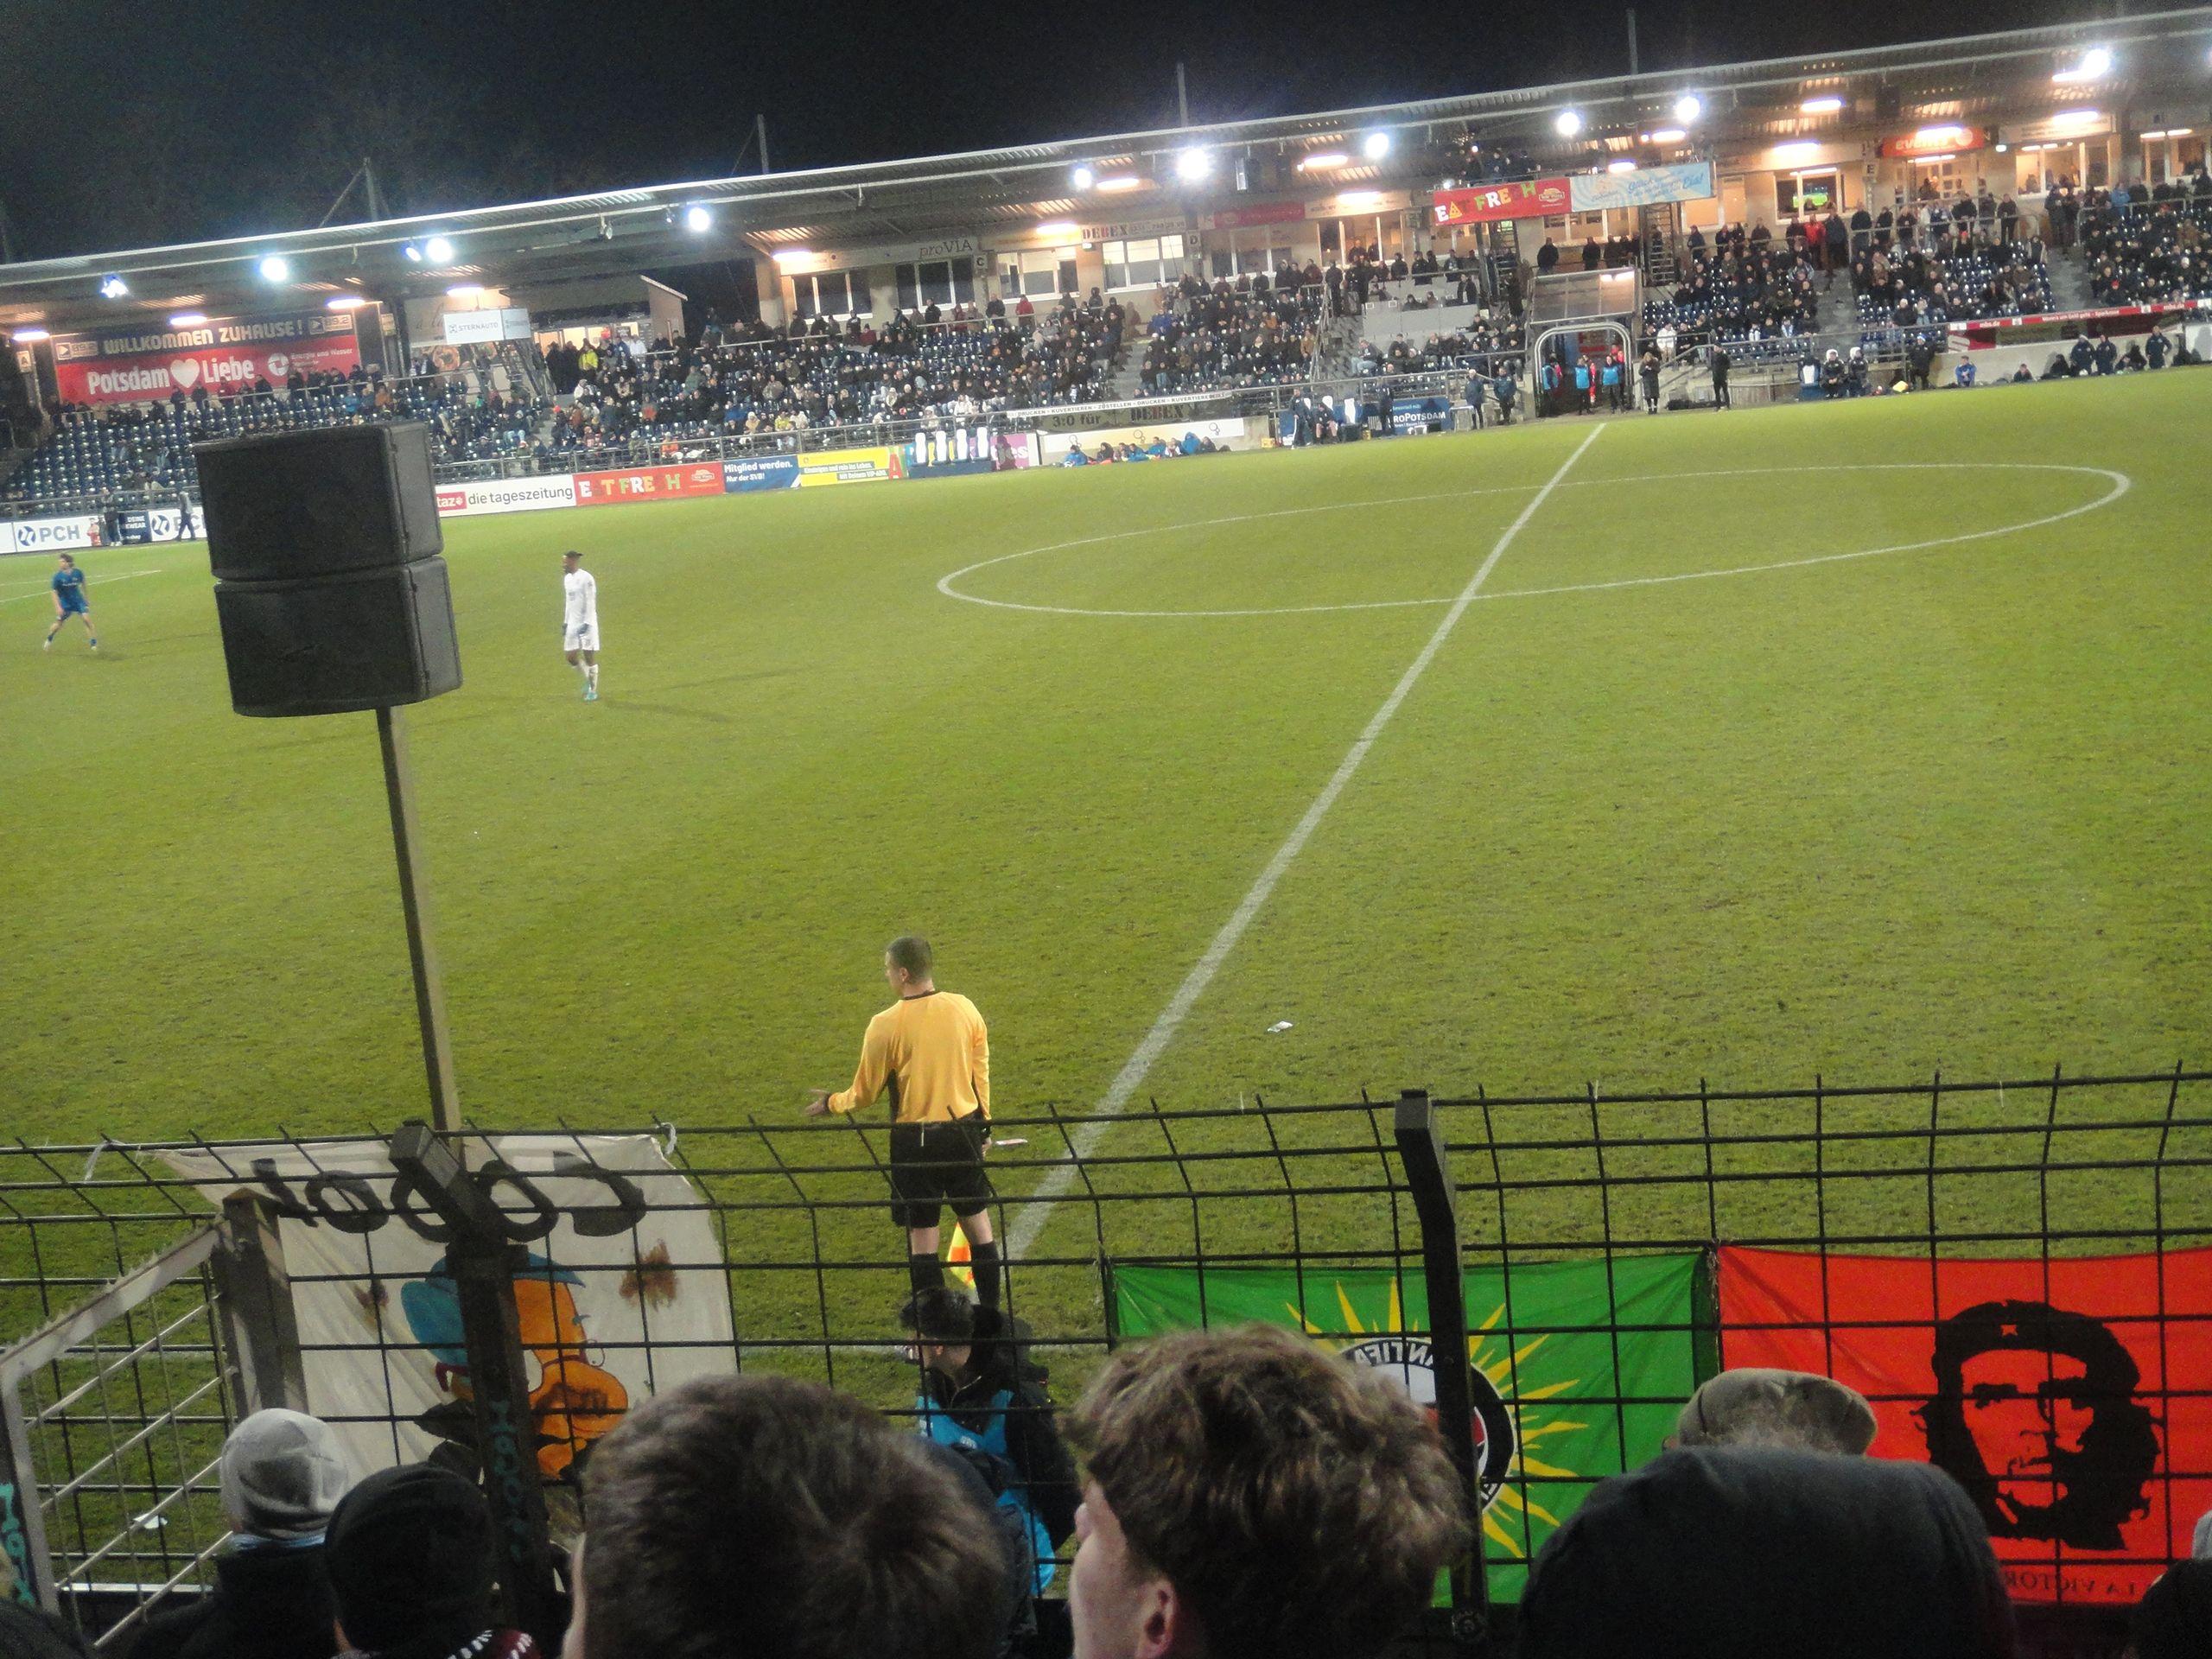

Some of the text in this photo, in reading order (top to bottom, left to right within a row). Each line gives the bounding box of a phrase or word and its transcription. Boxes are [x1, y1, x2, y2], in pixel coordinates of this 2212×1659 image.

[919, 239, 972, 259] proVIA
[458, 322, 499, 333] STERNAUTO
[104, 329, 213, 354] WILLKOMMEN
[87, 356, 255, 395] Potsdam Liebe
[1052, 415, 1075, 427] 3:0
[1081, 413, 1100, 424] für
[724, 460, 793, 474] Mitglied werden.
[620, 474, 681, 494] FREH
[437, 497, 455, 508] taz
[468, 486, 573, 505] die tageszeitung
[39, 524, 80, 542] PCH
